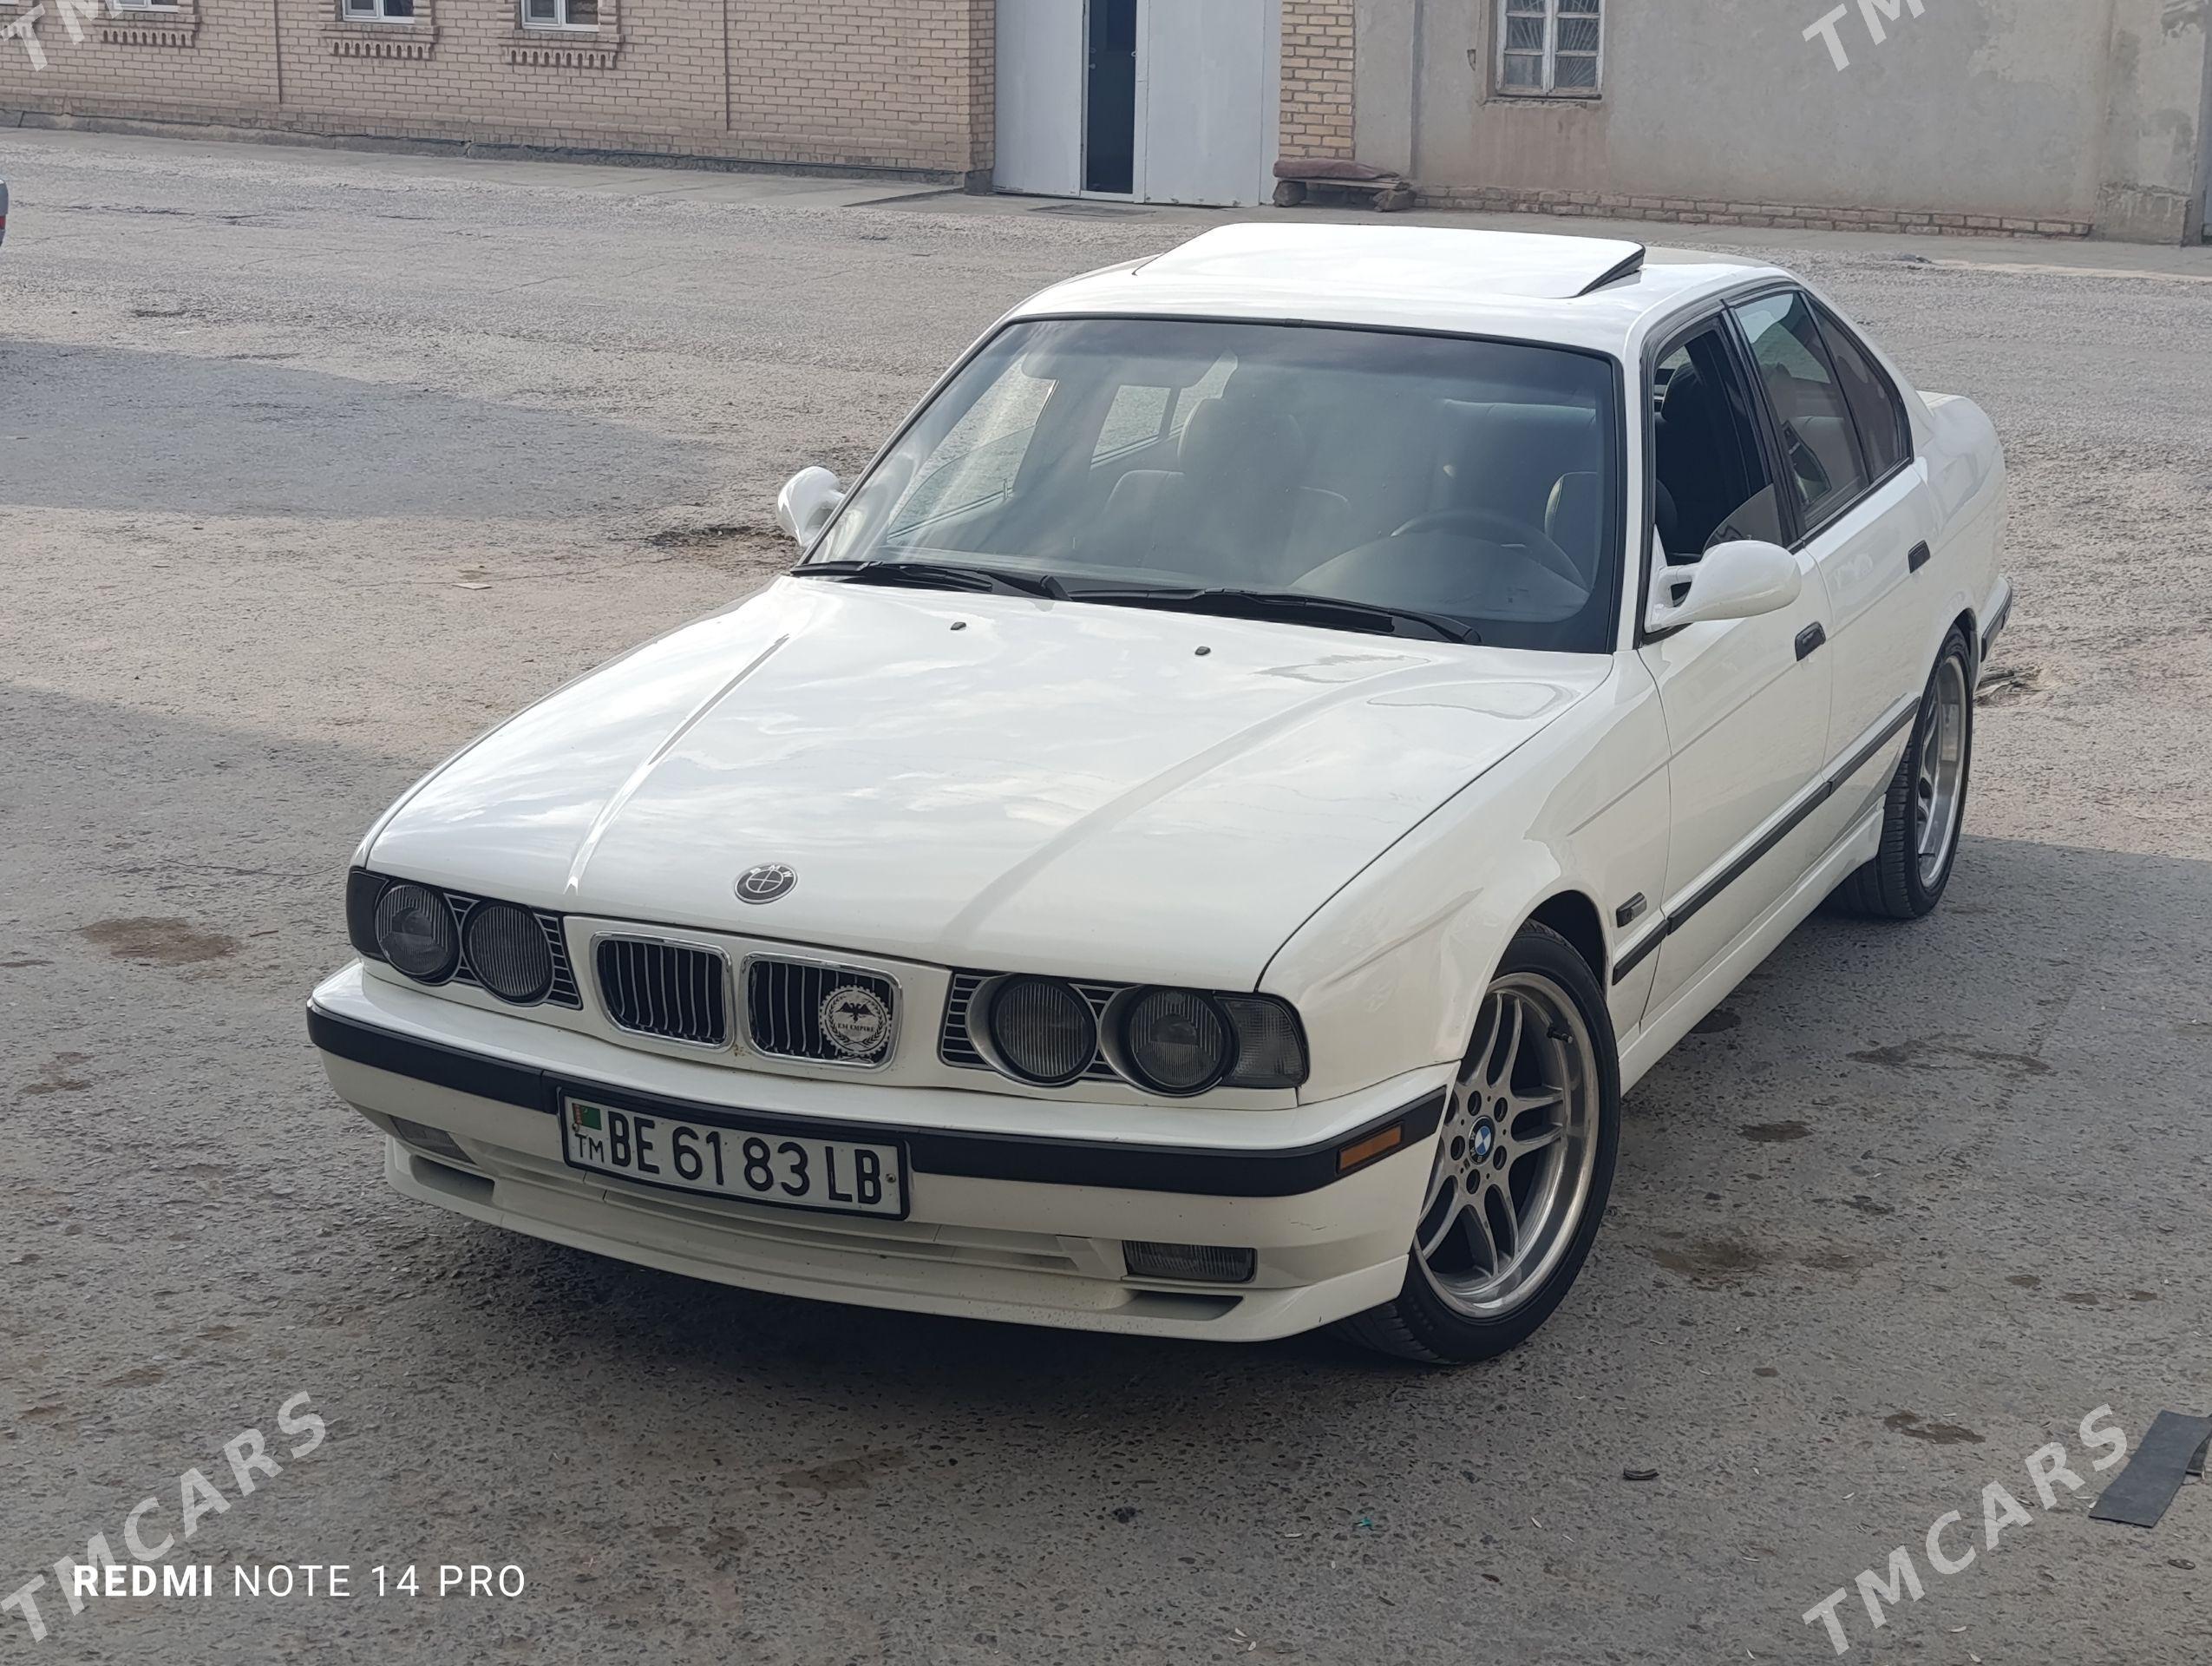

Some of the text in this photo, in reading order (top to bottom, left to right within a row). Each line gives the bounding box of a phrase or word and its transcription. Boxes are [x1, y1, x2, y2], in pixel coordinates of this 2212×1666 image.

[850, 1024, 874, 1033] EMPIRE
[574, 1131, 605, 1164] TM
[608, 1110, 881, 1205] BE 61 83 LB
